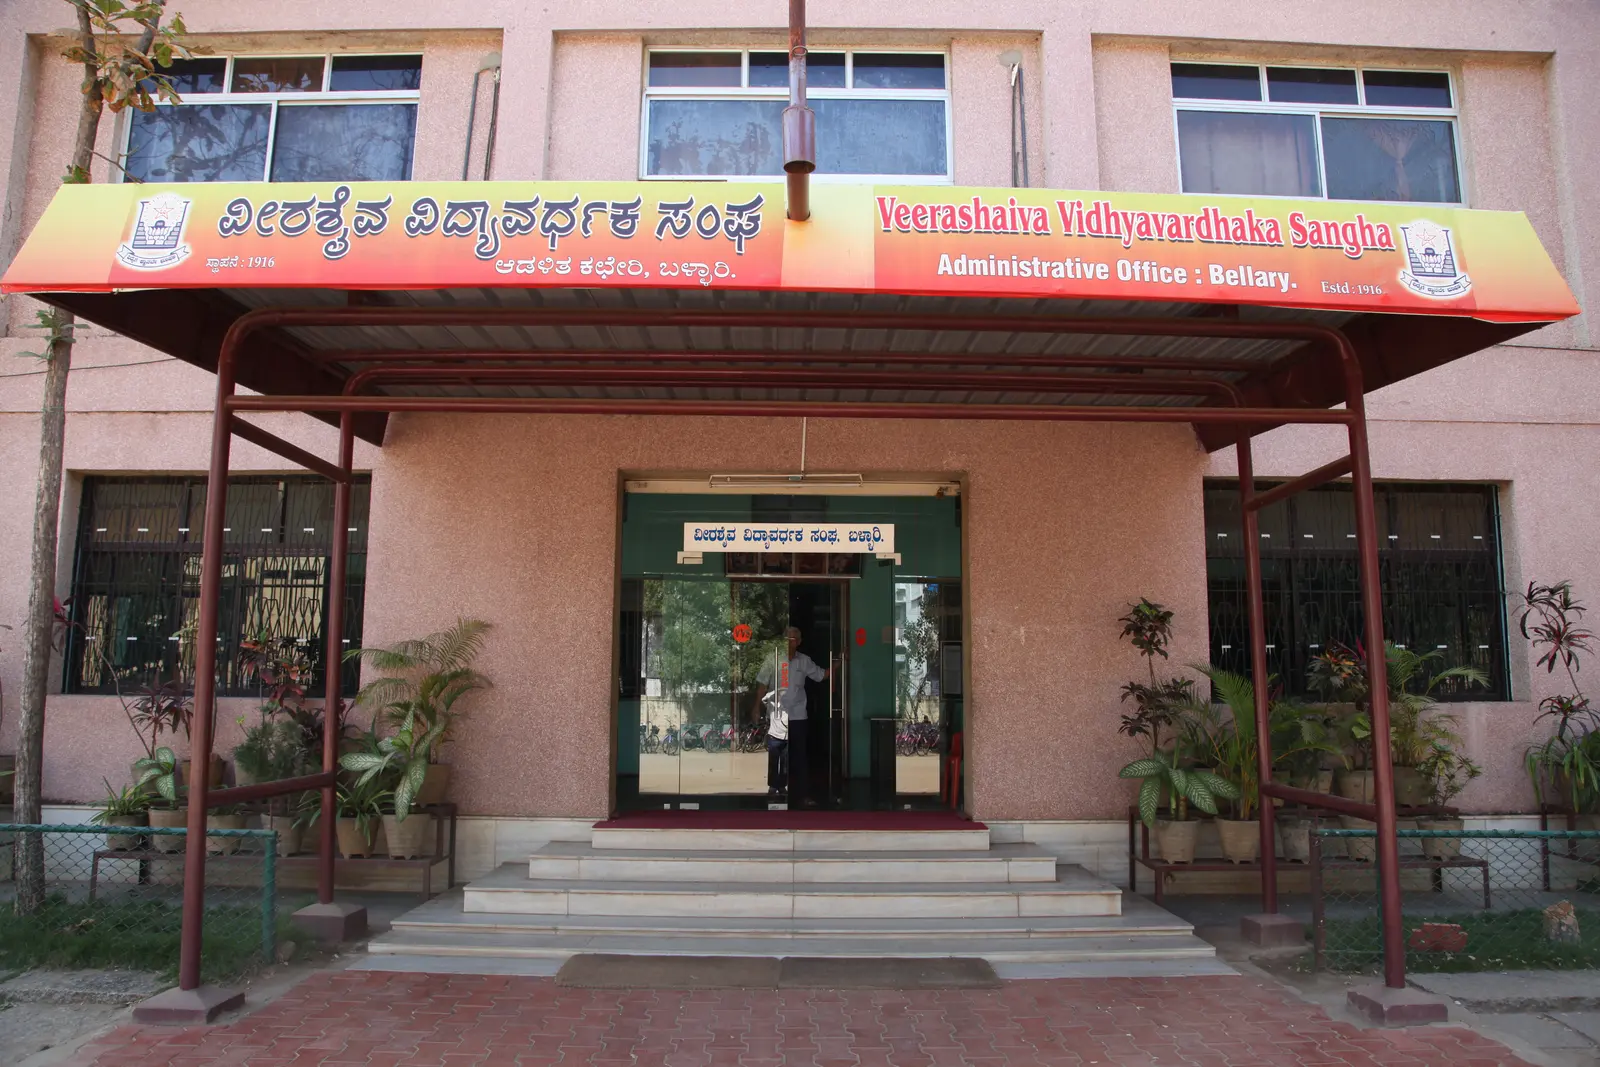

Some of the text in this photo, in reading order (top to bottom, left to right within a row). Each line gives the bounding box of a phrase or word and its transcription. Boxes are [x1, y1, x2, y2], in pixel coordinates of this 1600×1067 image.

[219, 185, 764, 259] ವೀರಶೈವ ವಿದ್ಯಾವರ್ಧಕ ಸಂಘ
[876, 196, 1396, 259] Veerashaiva Vidhyavardhaka Sangha
[247, 256, 275, 268] 1916
[495, 256, 736, 286] ಆಡಳಿತ ಕಛೇರಿ, ಬಳ್ಳಾರಿ.
[937, 254, 1109, 280] Administrative
[1117, 259, 1187, 284] Office
[1208, 264, 1297, 293] Bellary.
[1321, 281, 1350, 294] Estd
[1357, 284, 1383, 295] 1916
[694, 526, 736, 548] ವೀರಶೈವ
[743, 527, 804, 549] ವಿದ್ಯಾವರ್ಧಕ
